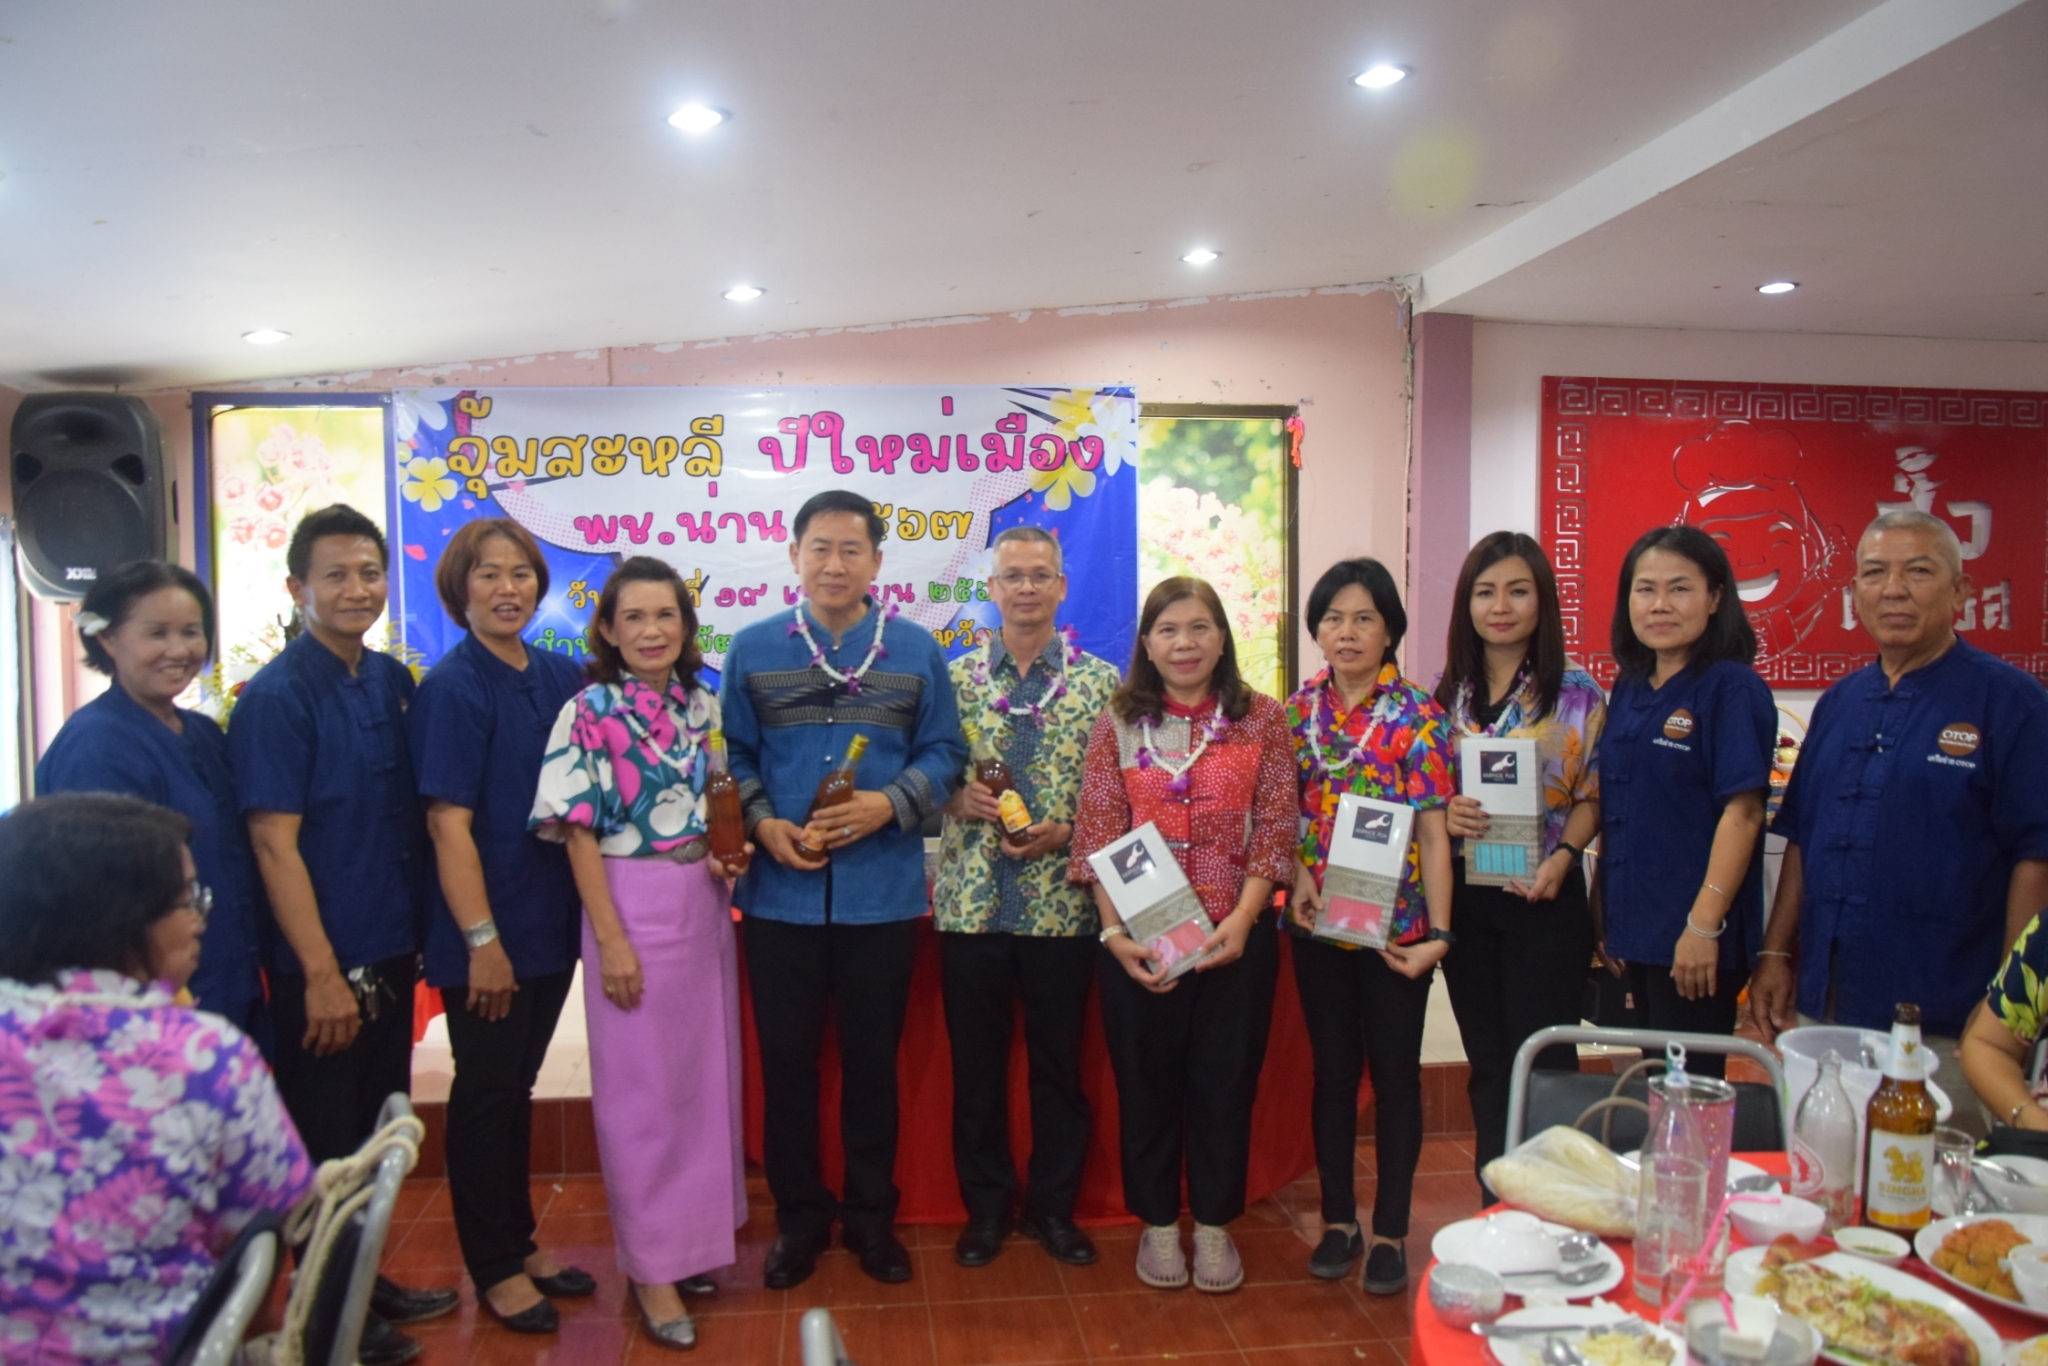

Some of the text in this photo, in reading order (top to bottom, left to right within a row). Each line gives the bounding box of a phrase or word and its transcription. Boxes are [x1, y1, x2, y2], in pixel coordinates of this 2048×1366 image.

[758, 396, 1105, 475] ปีใหม่เมือง
[573, 480, 788, 545] พช.น่าน
[1942, 729, 1978, 741] OTOP
